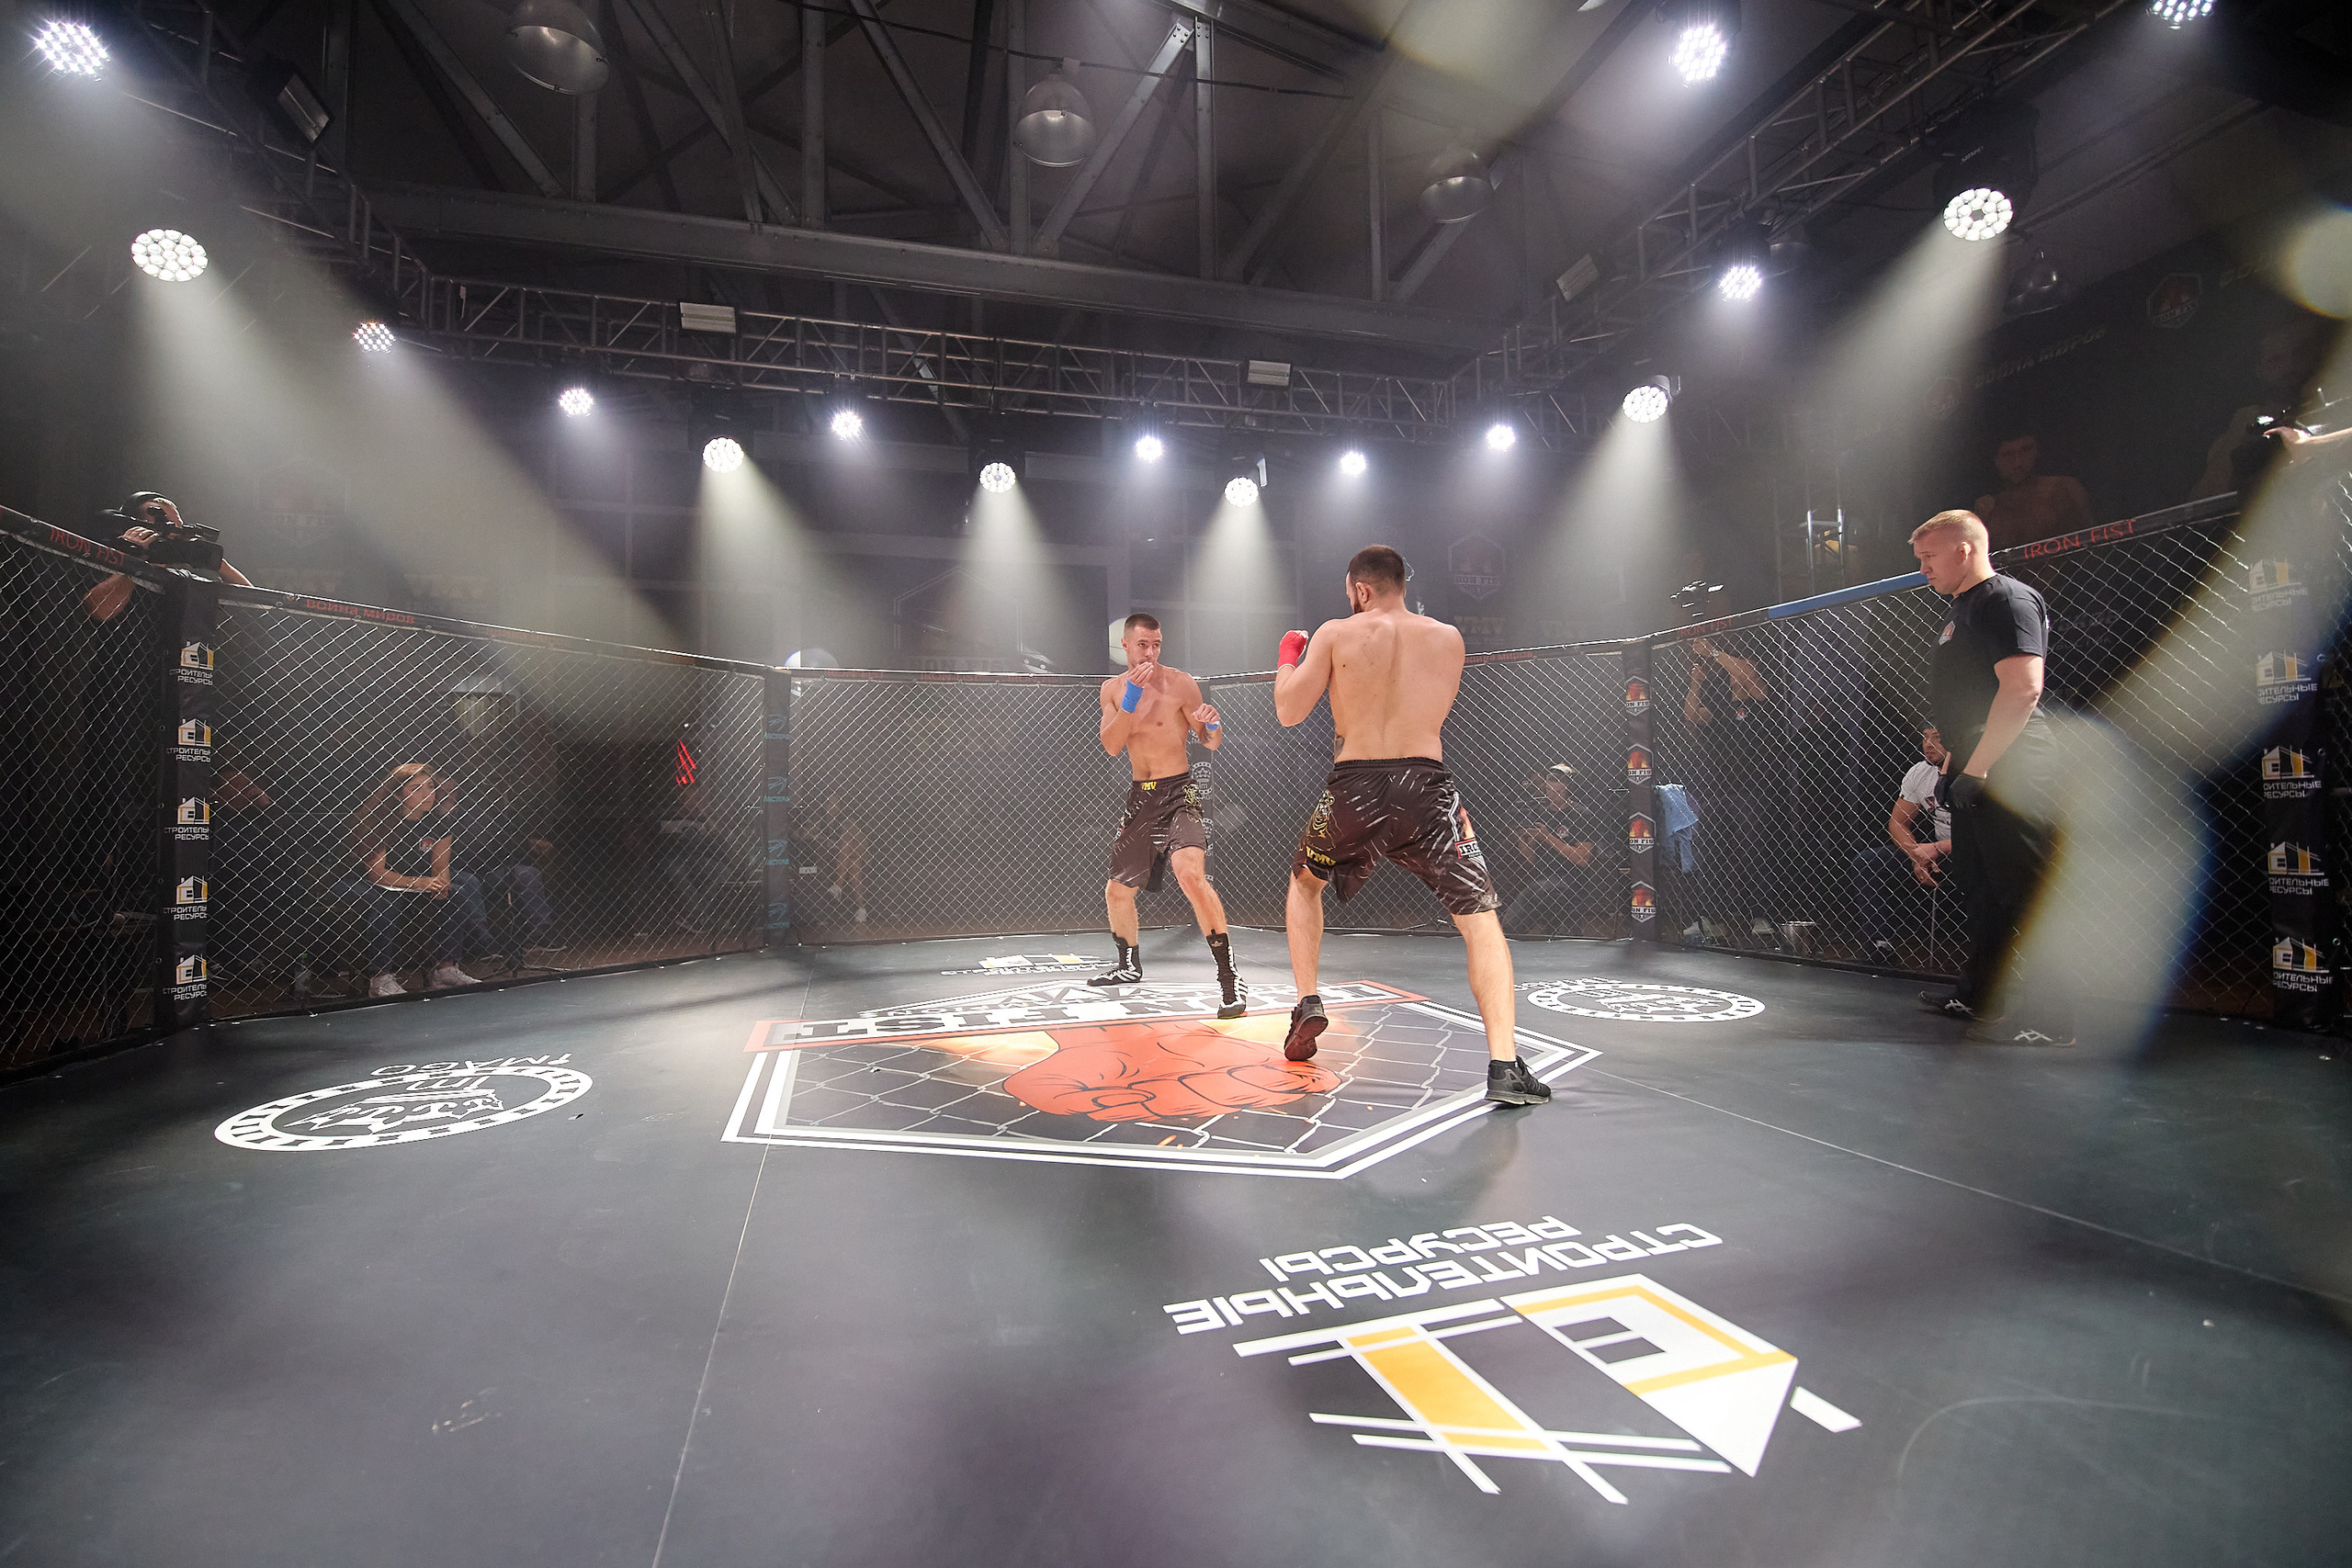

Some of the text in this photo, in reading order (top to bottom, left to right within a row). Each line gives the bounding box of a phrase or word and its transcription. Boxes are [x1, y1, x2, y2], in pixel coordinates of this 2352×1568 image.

[2024, 519, 2136, 559] IRON FIST
[782, 1006, 1080, 1042] FIST
[1258, 1214, 1583, 1283] РЕСУРСЫ
[1162, 1222, 1723, 1336] СТРОИТЕЛЬНЫЕ
